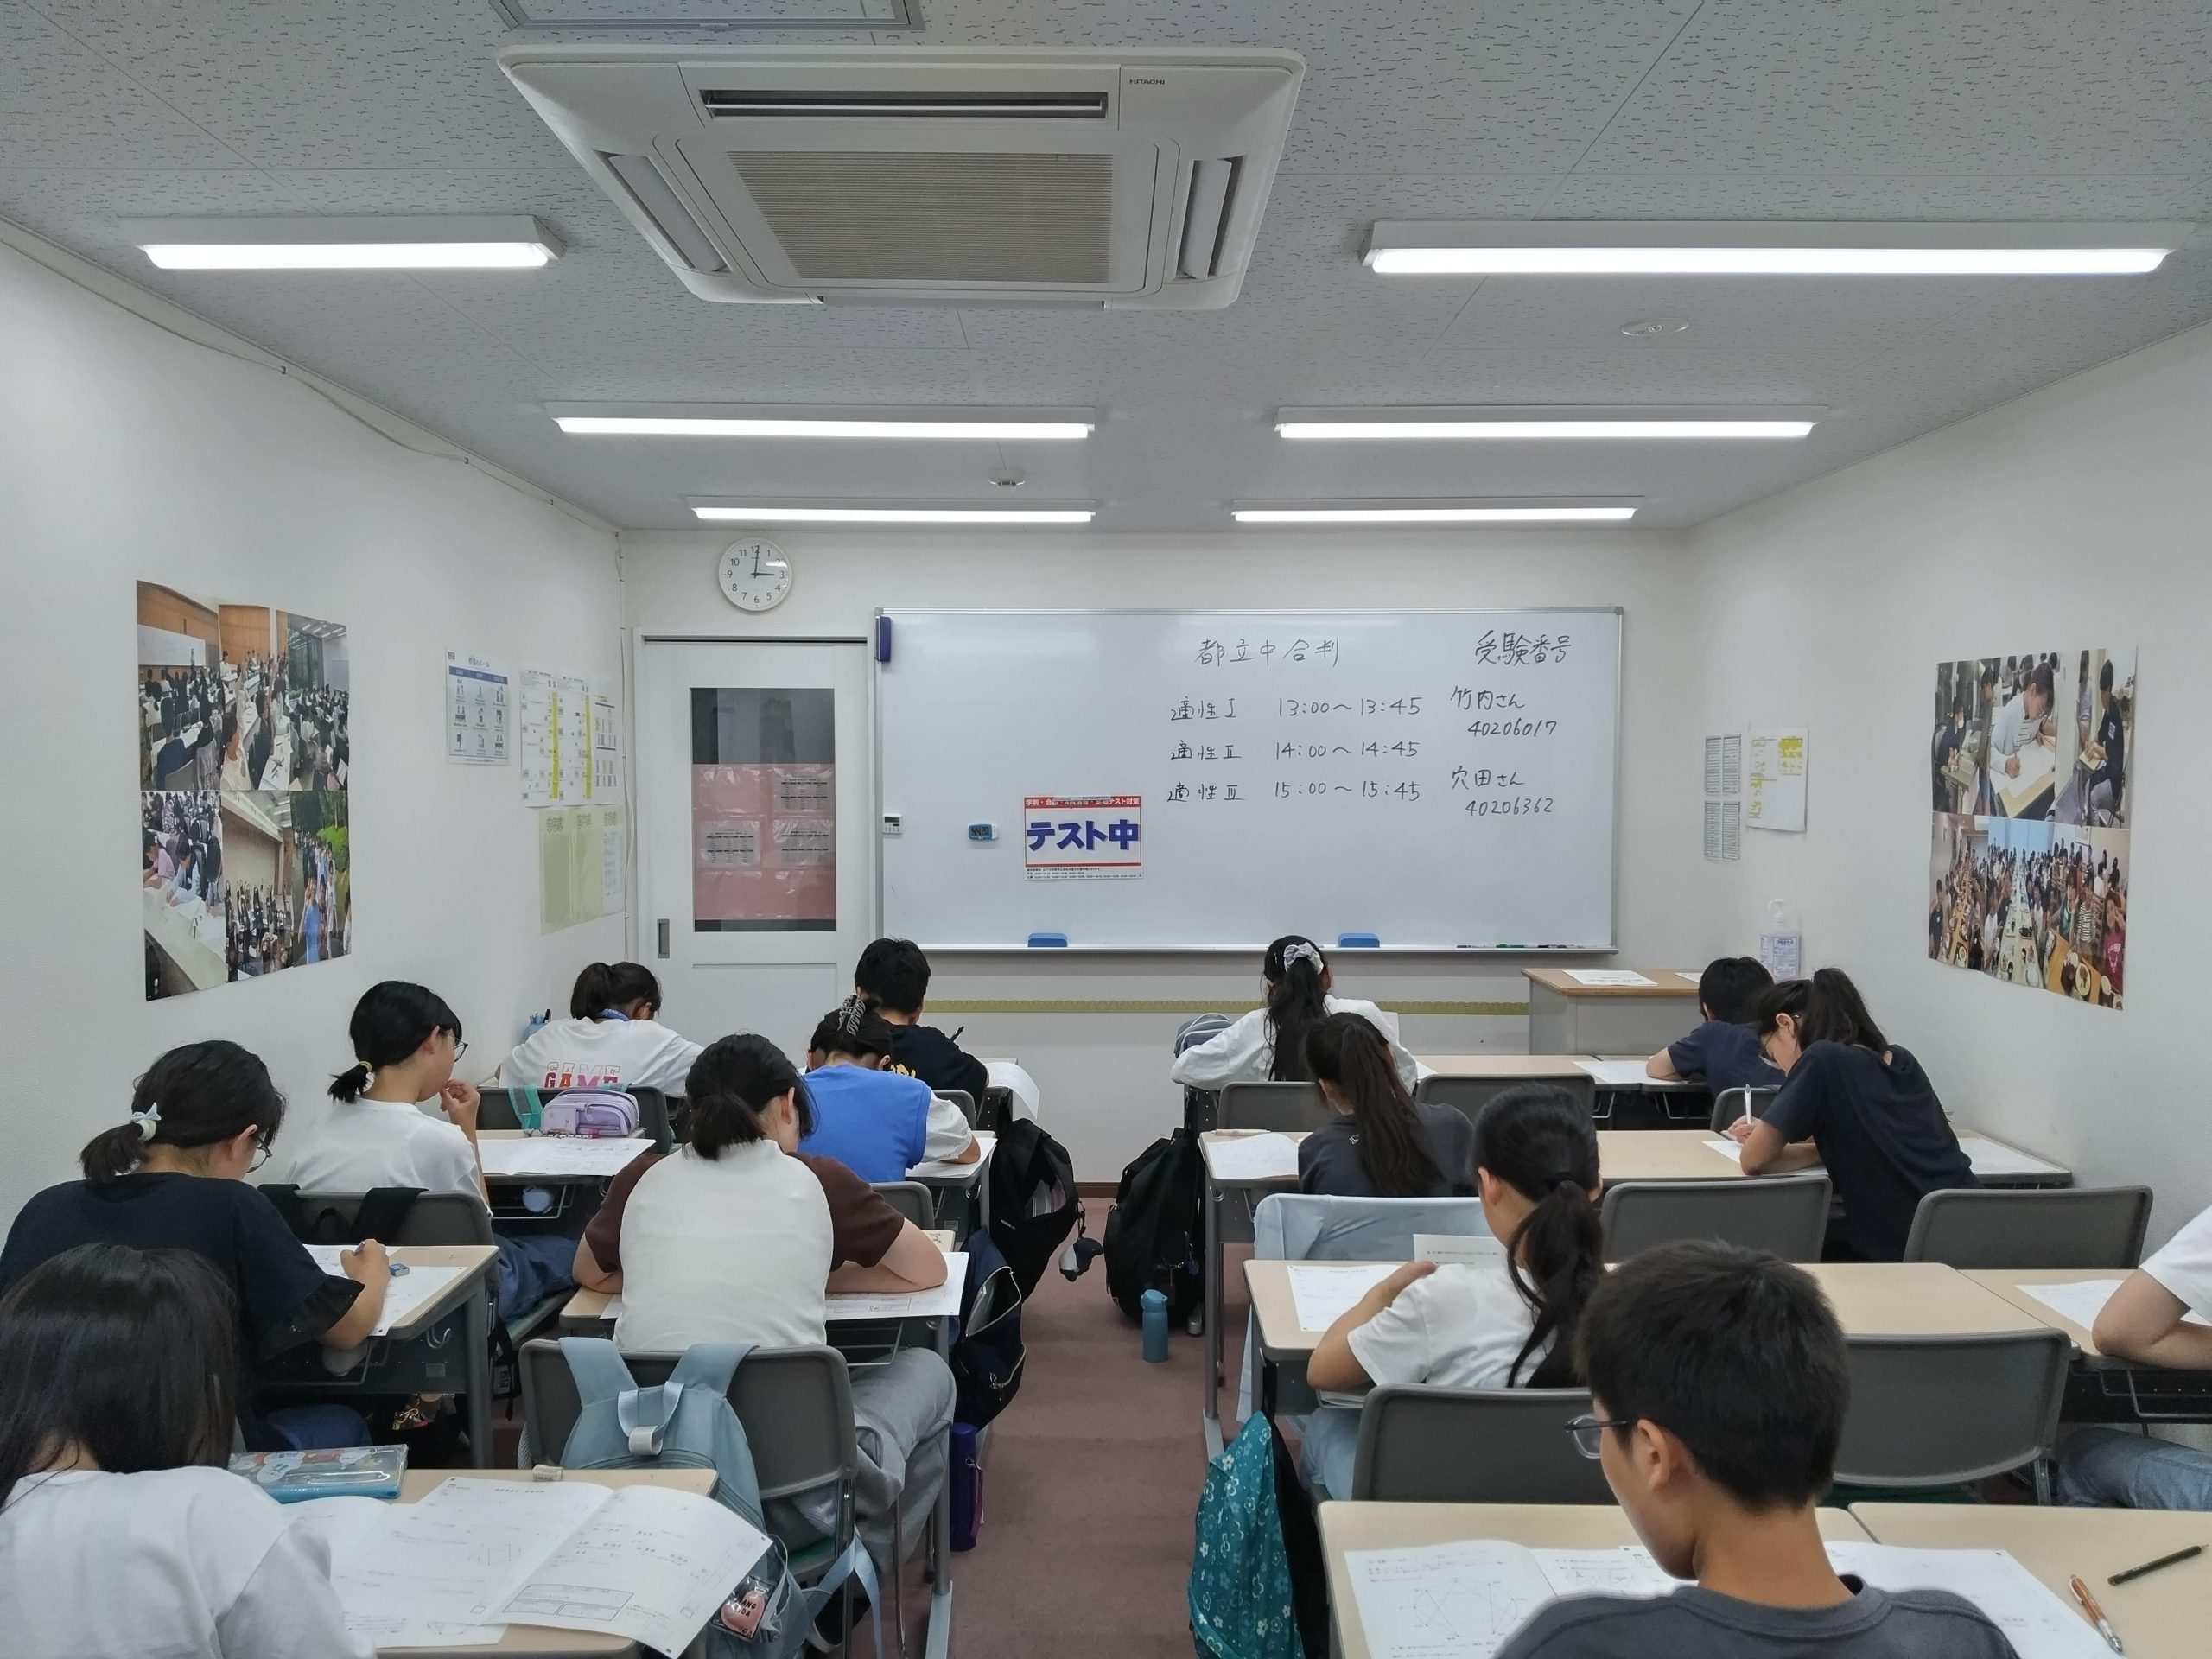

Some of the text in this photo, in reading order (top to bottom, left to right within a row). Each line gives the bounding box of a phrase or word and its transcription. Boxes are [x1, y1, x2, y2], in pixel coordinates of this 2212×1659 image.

[767, 549, 771, 557] 1
[727, 569, 733, 578] 9
[780, 570, 785, 579] 3
[732, 583, 738, 592] 8
[766, 592, 772, 601] 5
[1195, 638, 1339, 667] 都立中合判
[1475, 630, 1573, 666] 受験番号
[1450, 685, 1526, 710] 竹内さん
[1467, 718, 1558, 737] 40206017
[1451, 766, 1525, 790] 穴田さん
[1465, 797, 1554, 817] 40206362
[1027, 819, 1139, 851] テスト中
